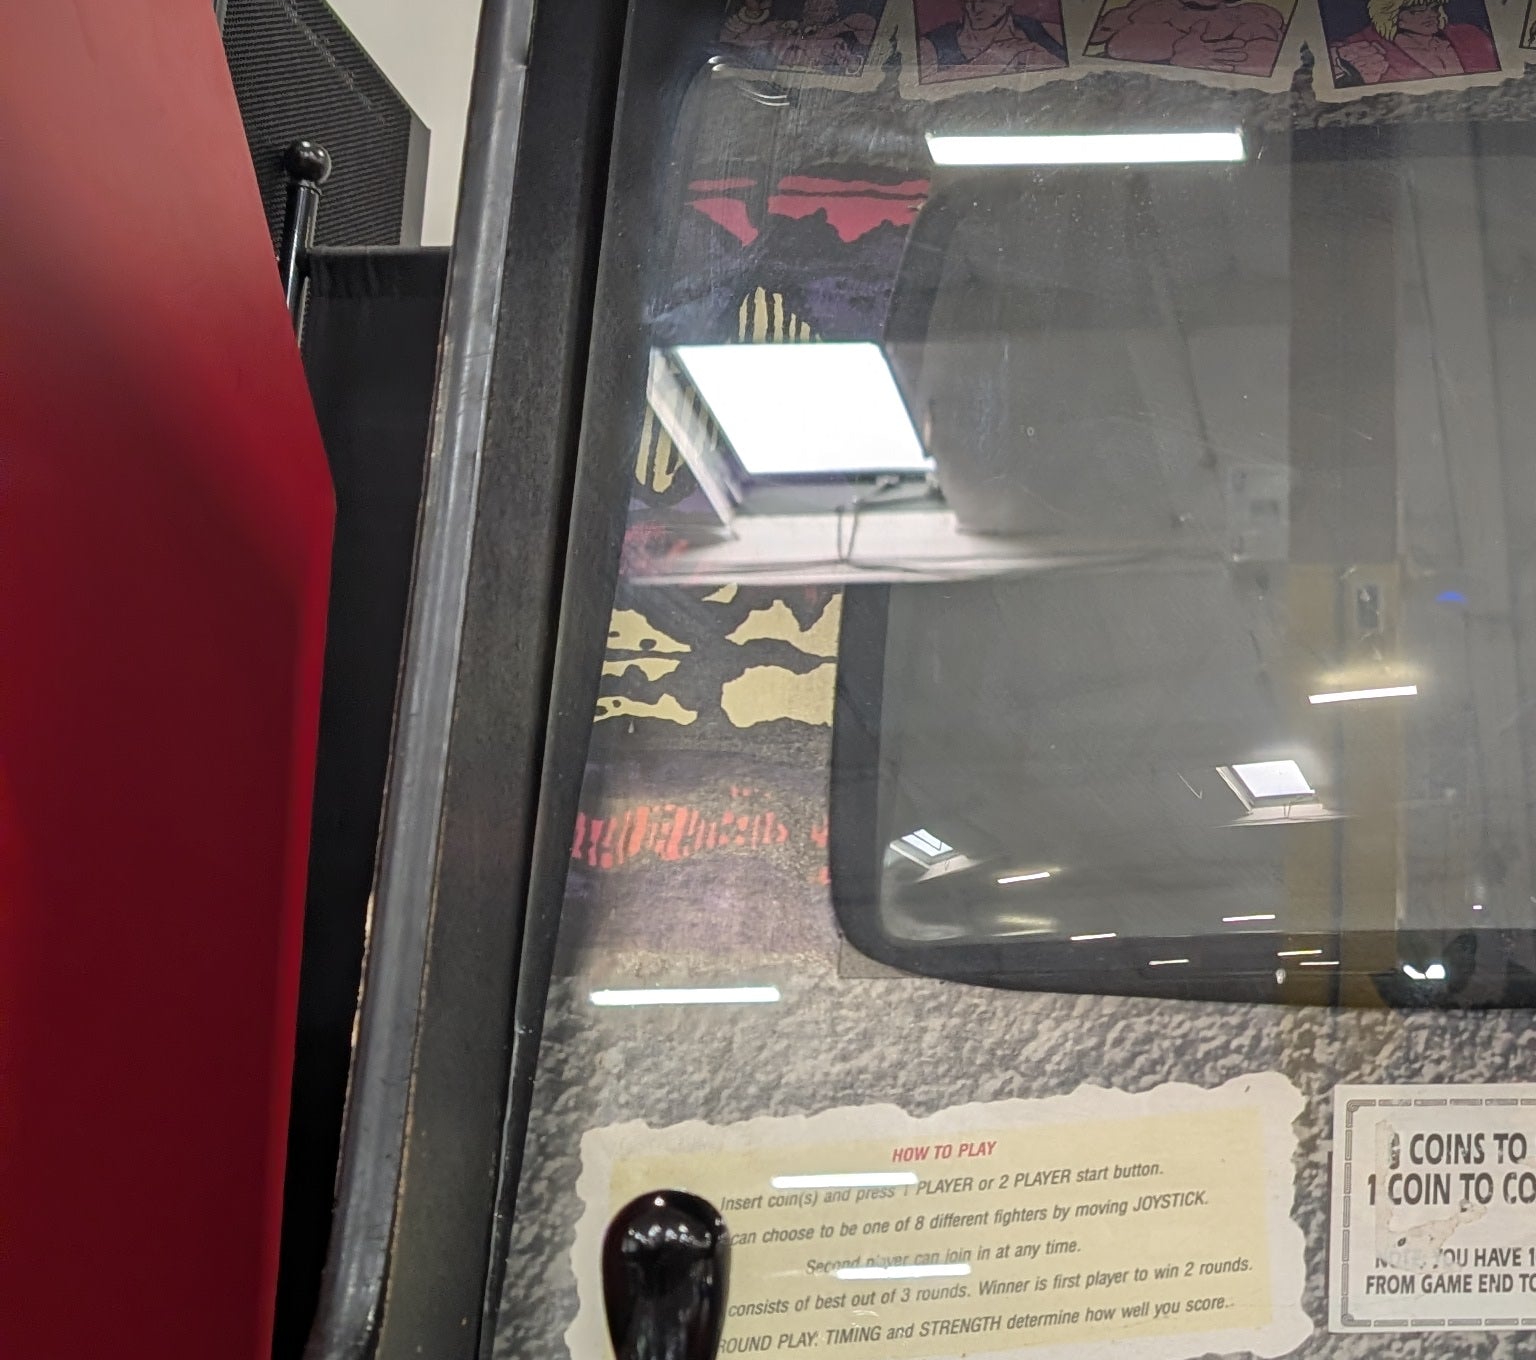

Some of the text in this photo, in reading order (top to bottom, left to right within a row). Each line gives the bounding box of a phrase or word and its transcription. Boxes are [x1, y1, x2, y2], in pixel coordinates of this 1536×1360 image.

[892, 1141, 998, 1163] HOW TO PLAY
[1409, 1132, 1485, 1165] COINS
[1493, 1132, 1527, 1164] TO
[720, 1196, 763, 1212] Insert
[767, 1191, 819, 1209] coin(s)
[823, 1189, 850, 1204] and
[855, 1188, 896, 1204] press
[915, 1177, 974, 1196] PLAYER
[978, 1177, 995, 1191] or
[998, 1173, 1009, 1189] 2
[1013, 1169, 1072, 1188] PLAYER
[1076, 1166, 1109, 1184] start
[1113, 1163, 1164, 1180] button.
[1367, 1173, 1377, 1206] 1
[1388, 1172, 1452, 1206] COIN
[1459, 1172, 1495, 1205] TO
[730, 1190, 1209, 1246] can choose to be one of 8 different fighters by moving JOYSTICK.
[913, 1252, 940, 1266] can
[944, 1248, 972, 1265] join
[976, 1245, 992, 1262] in
[995, 1243, 1010, 1259] at
[1014, 1242, 1041, 1259] any
[1045, 1239, 1082, 1256] time.
[1473, 1247, 1522, 1268] HAVE
[727, 1257, 1253, 1318] consists of best out of 3 rounds. Winner is first player to win 2 rounds.
[1365, 1273, 1416, 1295] FROM
[1420, 1273, 1473, 1294] GAME
[1478, 1273, 1514, 1294] END
[825, 1325, 882, 1346] TIMING
[886, 1322, 914, 1340] and
[918, 1315, 1003, 1337] STRENGTH
[1006, 1309, 1080, 1330] determine
[1084, 1305, 1116, 1323] how
[1121, 1301, 1150, 1319] well
[1153, 1300, 1181, 1319] you
